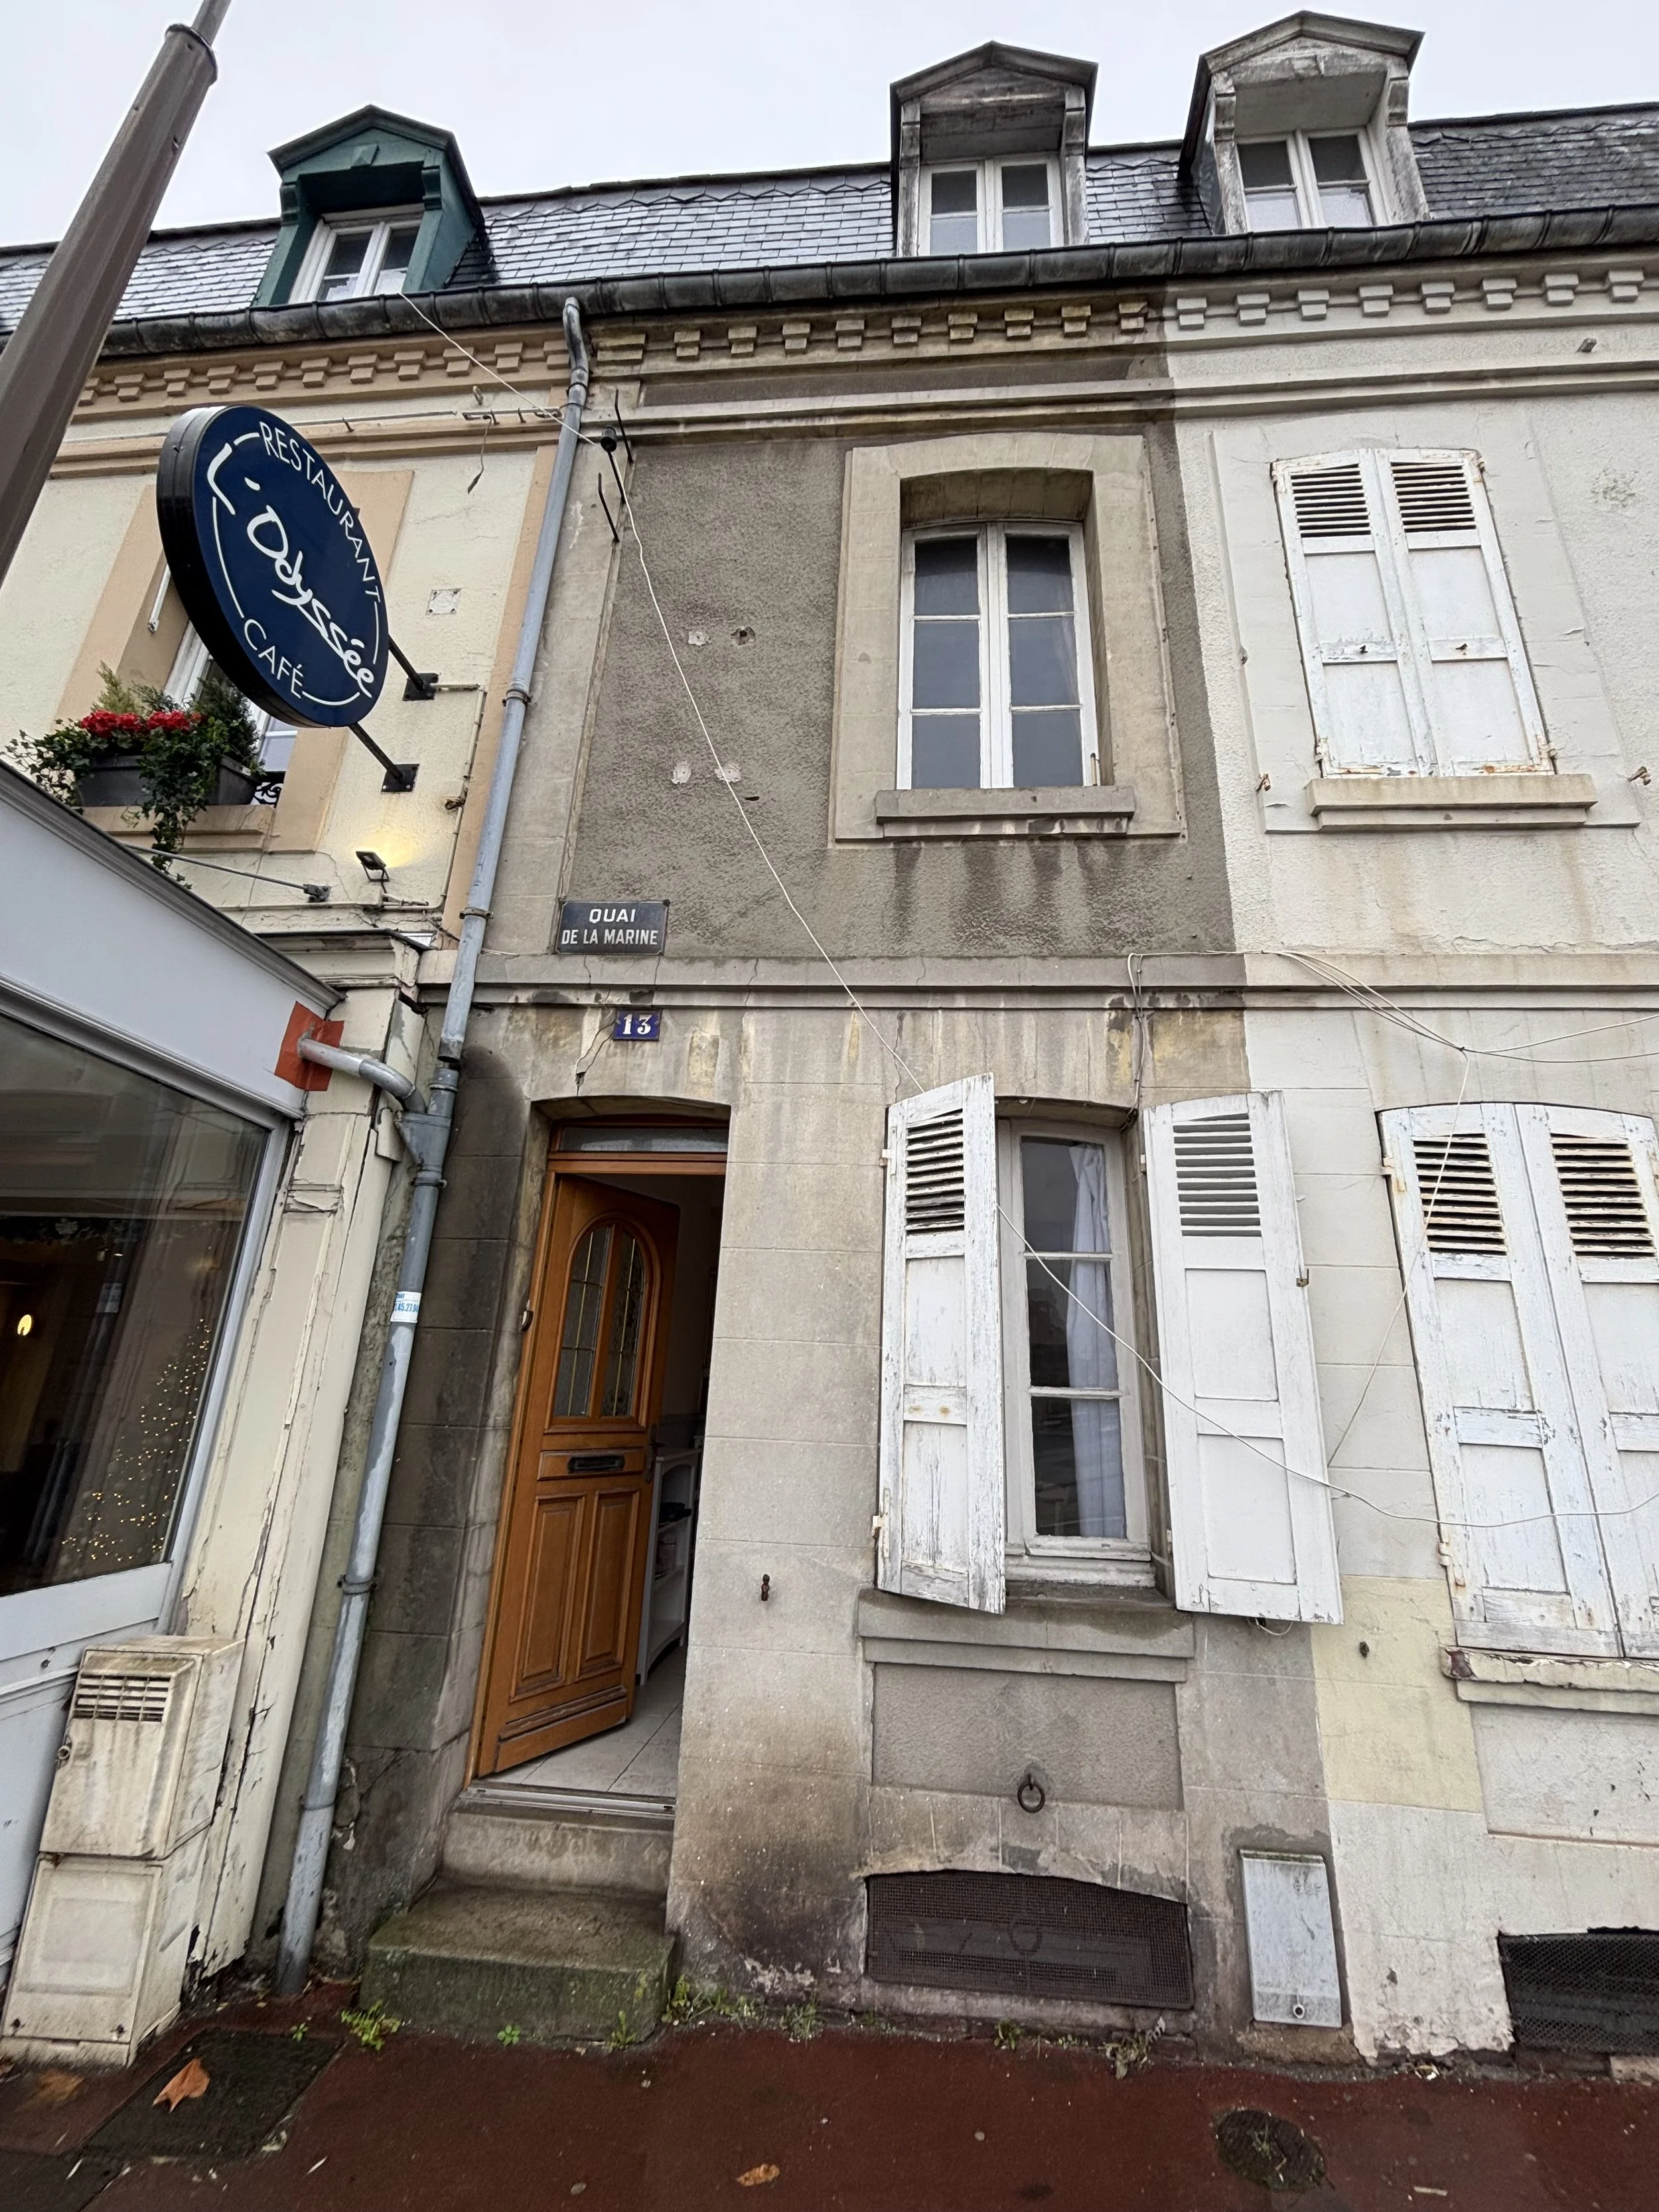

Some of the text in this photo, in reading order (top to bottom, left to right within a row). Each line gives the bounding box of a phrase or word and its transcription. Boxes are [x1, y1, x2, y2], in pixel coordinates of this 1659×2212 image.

[259, 421, 382, 603] RESTAURANT
[244, 619, 304, 699] CAFÉ
[589, 909, 636, 923] QUAI
[561, 929, 658, 945] DE LA MARINE
[622, 1014, 652, 1035] 13
